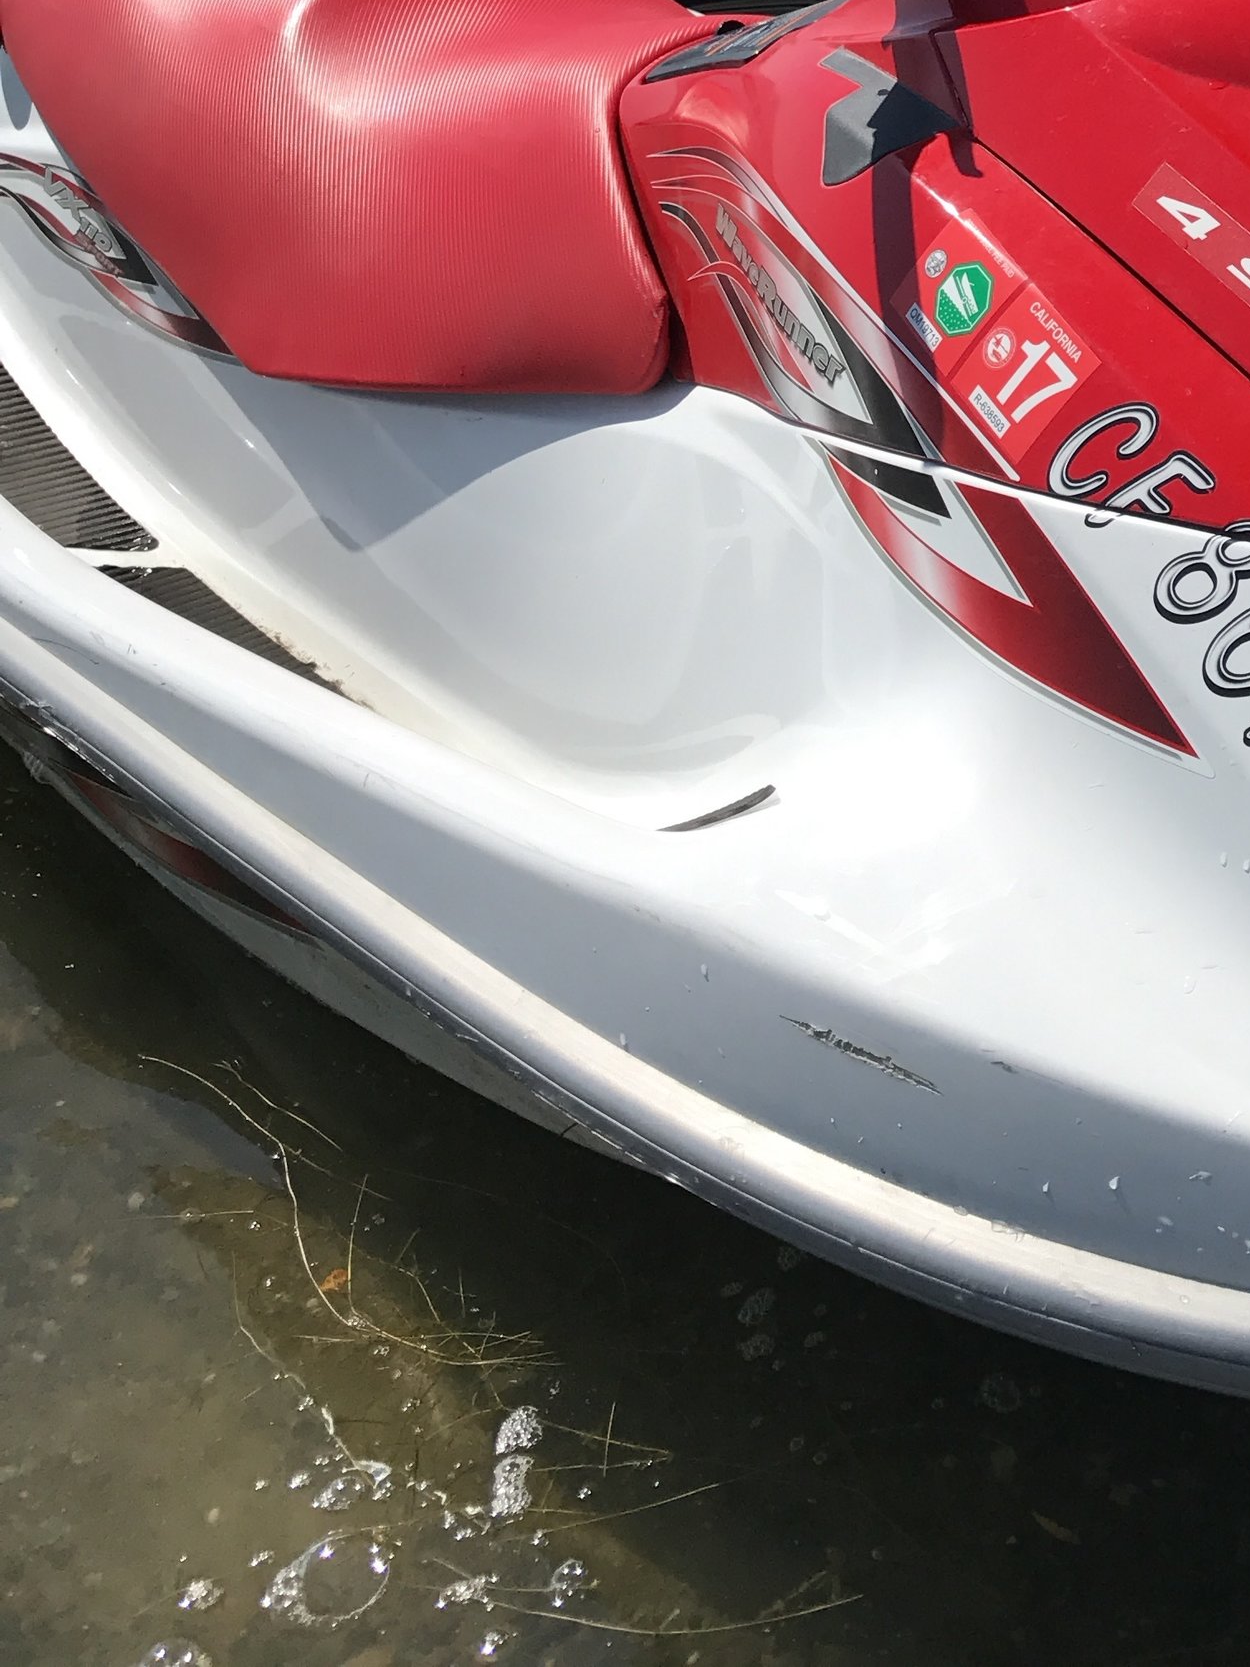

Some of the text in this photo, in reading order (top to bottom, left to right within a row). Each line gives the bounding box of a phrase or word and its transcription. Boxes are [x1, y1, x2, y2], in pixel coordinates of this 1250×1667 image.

[1155, 194, 1221, 240] 4
[715, 202, 847, 385] WaveRunner
[1029, 301, 1083, 364] CALIFORNIA
[973, 393, 1005, 433] R-638593
[995, 339, 1079, 424] 17
